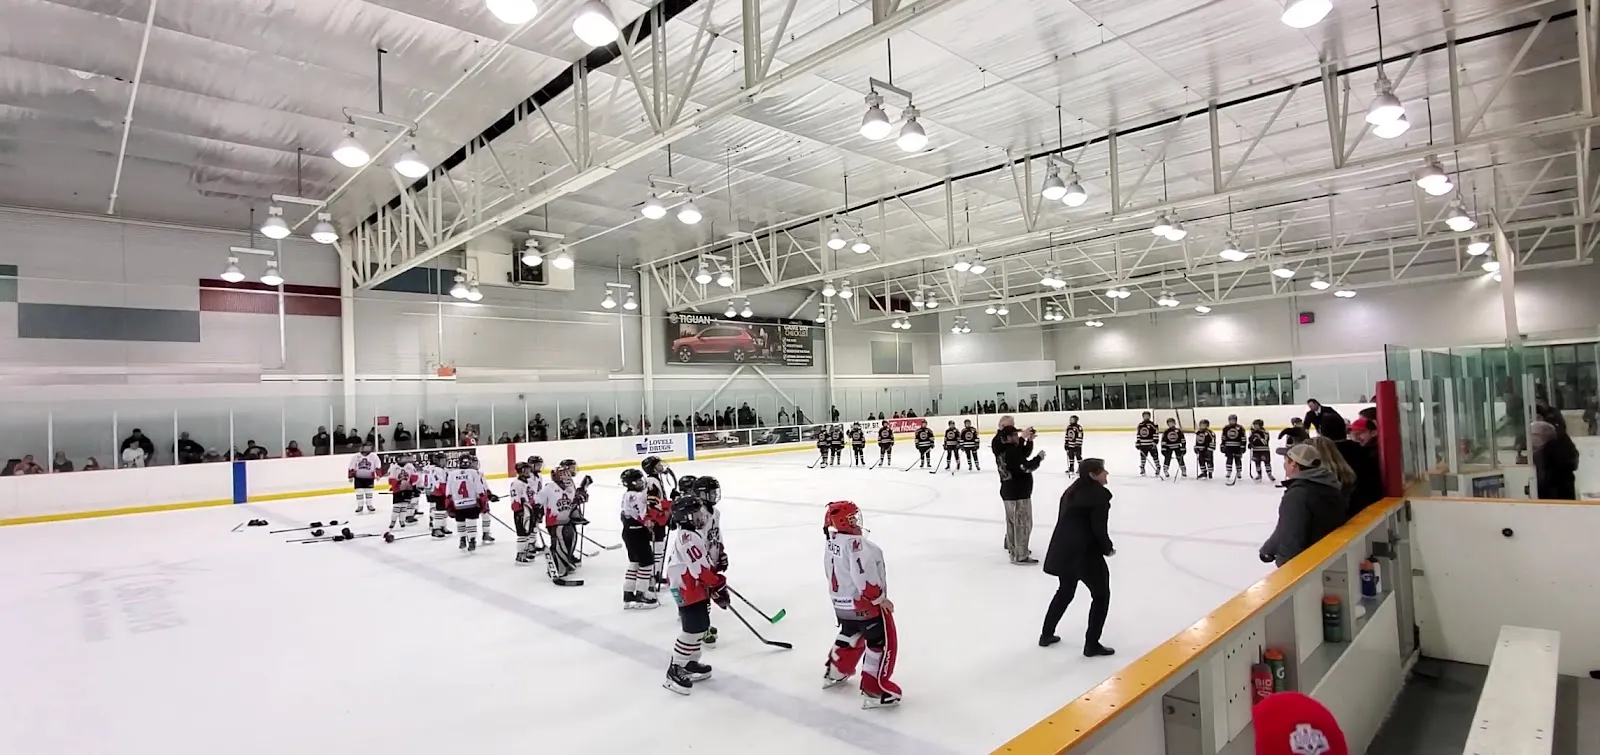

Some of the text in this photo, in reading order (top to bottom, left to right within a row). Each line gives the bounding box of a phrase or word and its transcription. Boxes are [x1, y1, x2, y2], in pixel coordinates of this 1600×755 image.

[679, 314, 711, 325] TIGUAN
[889, 422, 900, 433] Tim
[649, 438, 674, 446] LOVELL
[457, 480, 469, 498] 4
[686, 544, 703, 563] 10
[856, 557, 865, 574] 1
[1362, 573, 1373, 582] G
[1276, 667, 1285, 679] G
